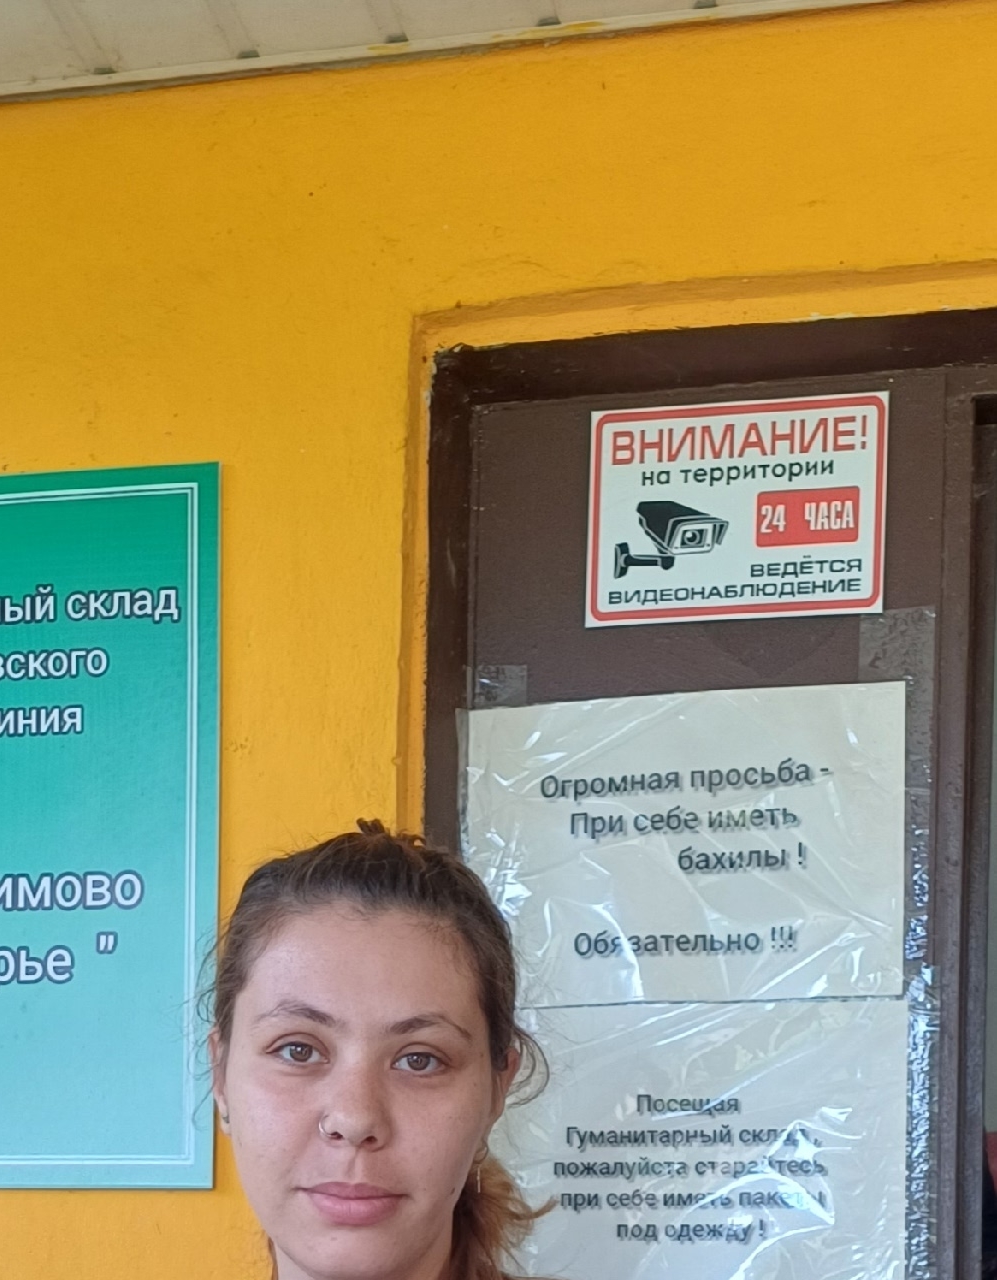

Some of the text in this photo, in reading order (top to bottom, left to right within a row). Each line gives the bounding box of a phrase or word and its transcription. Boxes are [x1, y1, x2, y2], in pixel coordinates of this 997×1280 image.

[611, 415, 867, 465] ВНИМАНИЕ!
[641, 459, 834, 486] на территории
[760, 500, 854, 533] 24 ЧАСА
[750, 555, 862, 578] ВЕДЁТСЯ
[66, 587, 179, 621] склад
[608, 578, 861, 605] ВИДЕОНАБЛЮДЕНИЕ
[540, 771, 681, 801] Огромная
[690, 757, 811, 793] просьба
[570, 805, 798, 839] При себе иметь
[574, 929, 760, 956] Обязательно
[637, 1094, 740, 1117] Посещая
[566, 1124, 732, 1149] Гуманитарный
[553, 1157, 688, 1180] пожалуйста
[560, 1193, 600, 1213] при
[606, 1189, 659, 1207] себе
[616, 1223, 659, 1240] под
